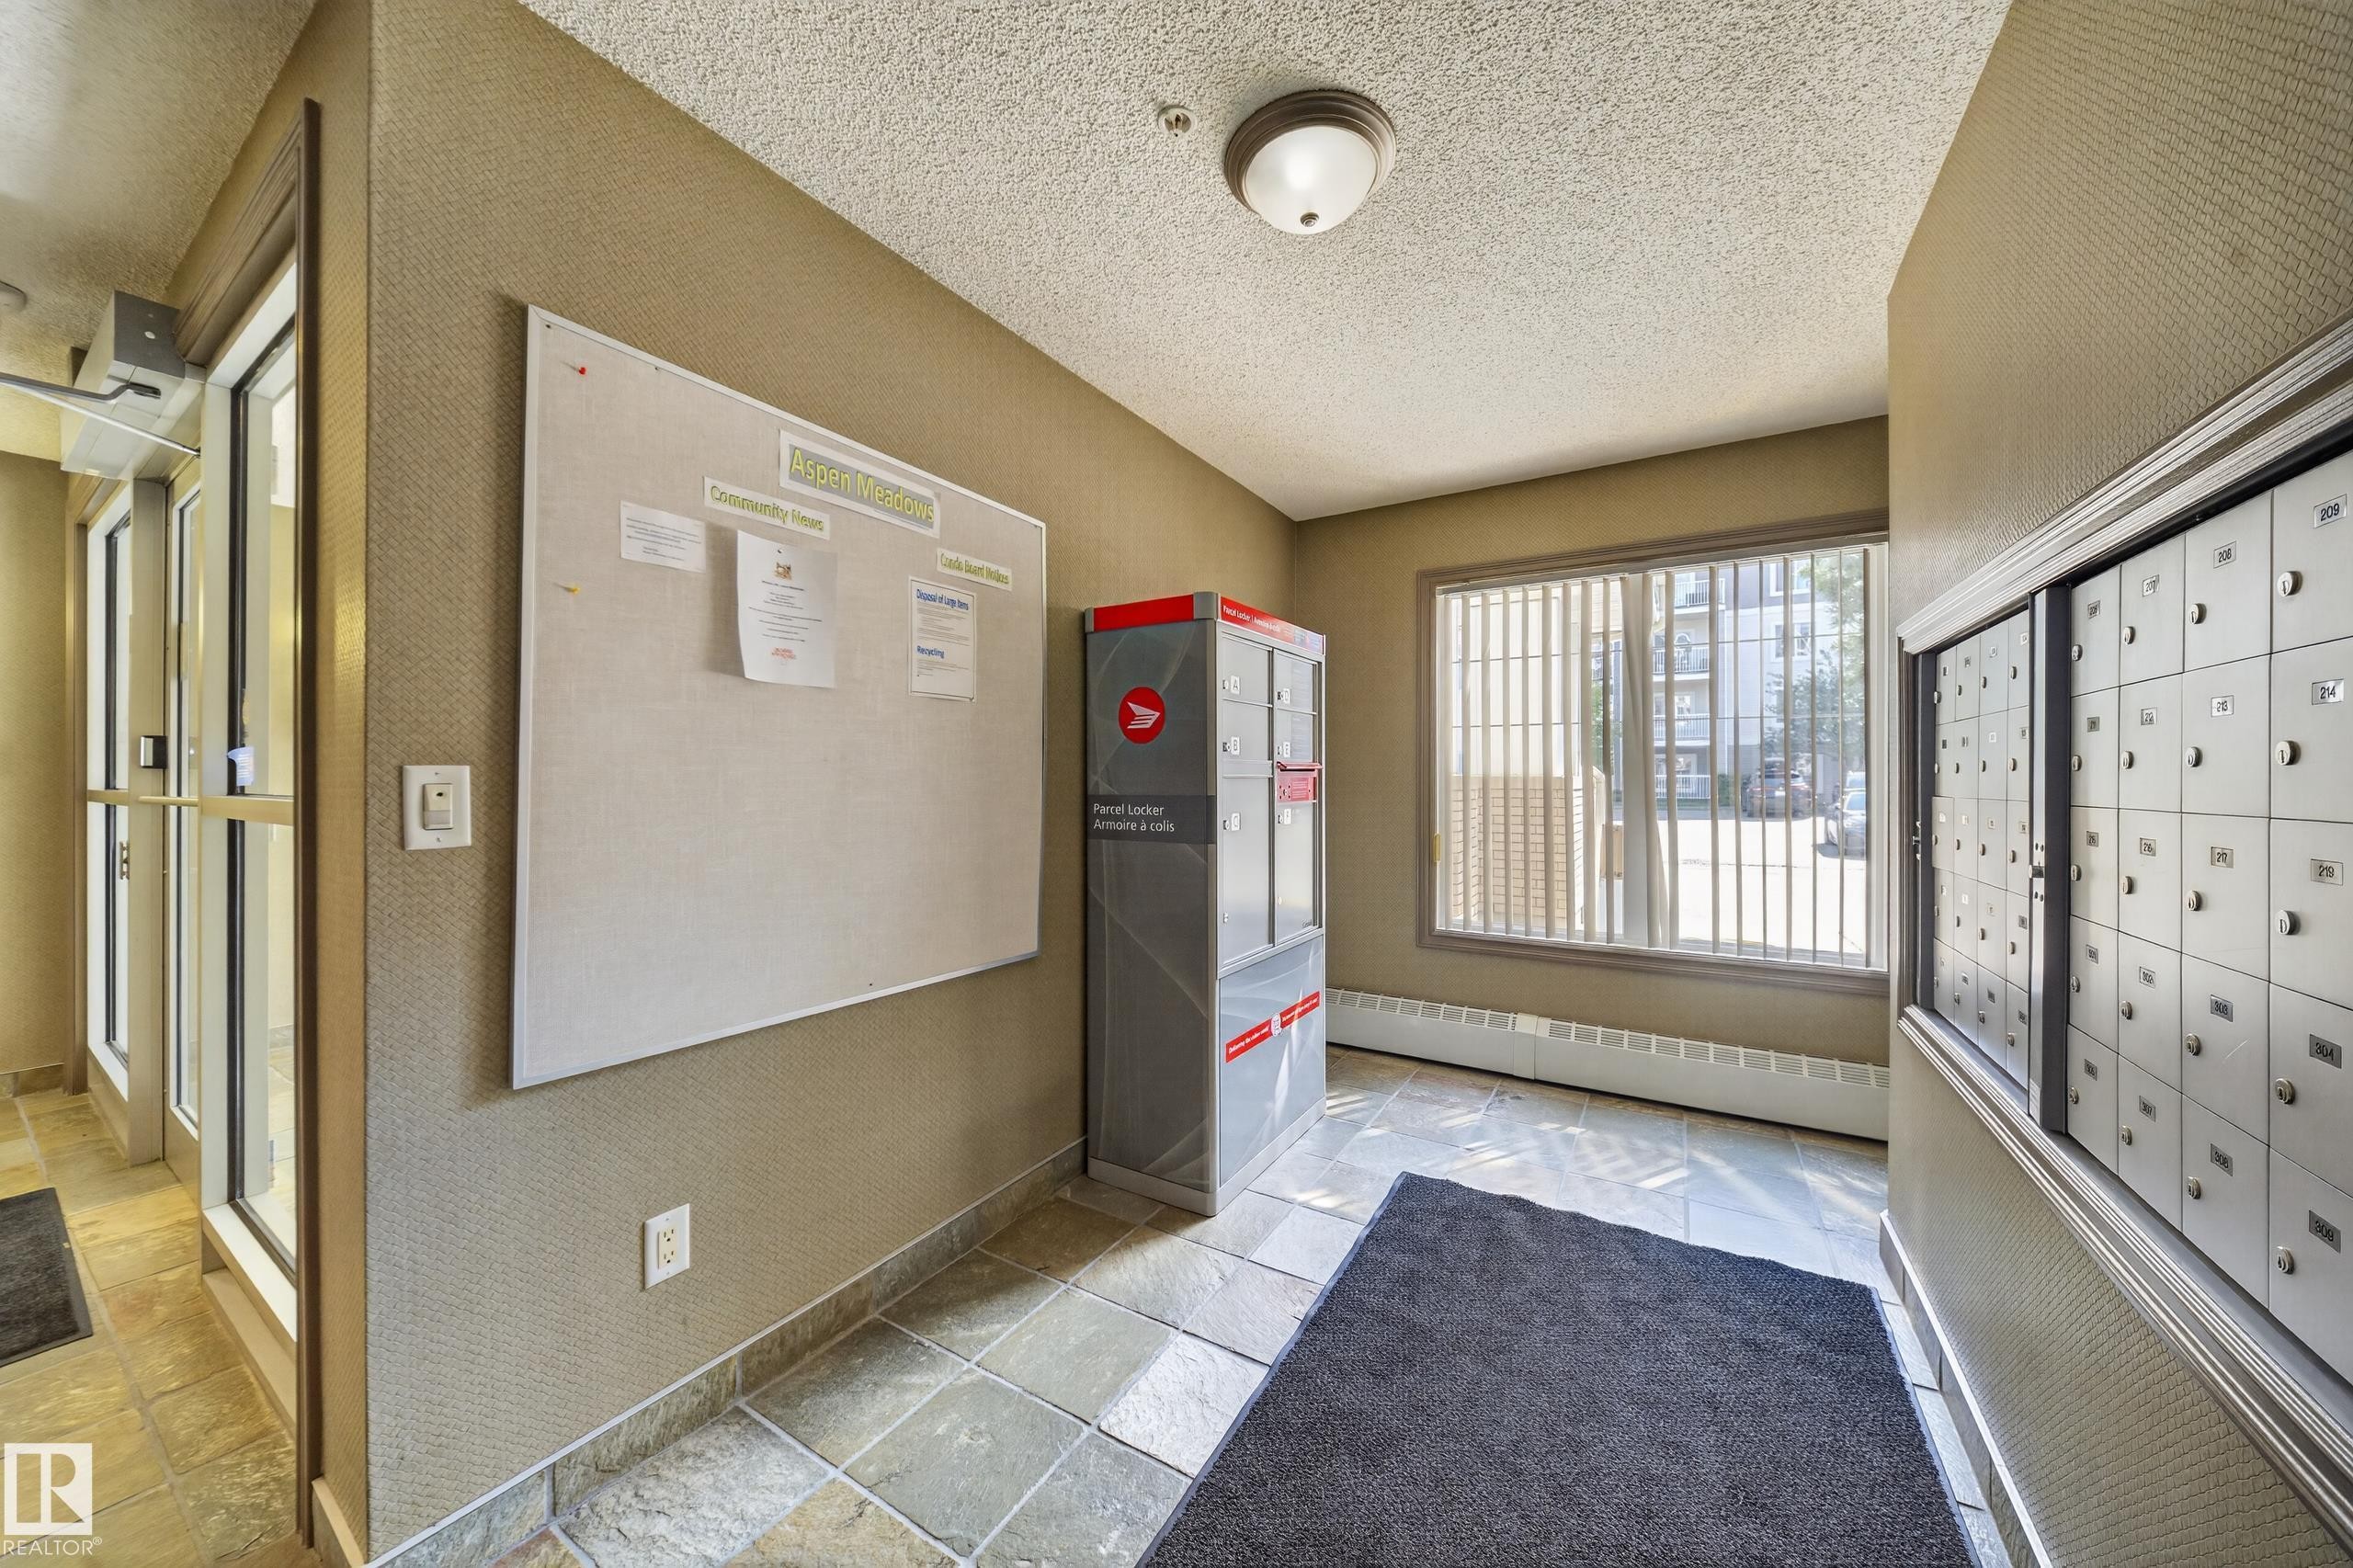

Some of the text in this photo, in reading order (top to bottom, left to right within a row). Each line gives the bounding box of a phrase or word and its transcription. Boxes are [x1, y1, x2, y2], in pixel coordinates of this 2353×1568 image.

[791, 448, 935, 522] Aspen Meadows
[710, 485, 824, 530] Community News
[2320, 503, 2340, 522] 209
[2218, 548, 2232, 562] 208
[940, 552, 1009, 585] Condo Board Notices
[2145, 580, 2156, 593] 207
[916, 588, 938, 603] Disposal
[938, 593, 944, 603] of
[945, 596, 957, 608] Large
[1222, 605, 1251, 621] Parcel Locker
[916, 645, 945, 659] Recycling
[2320, 686, 2336, 699] 214
[2216, 700, 2229, 712] 213
[1093, 803, 1165, 816] Parcel Locker
[1093, 818, 1175, 833] Armoire à colis
[2216, 852, 2228, 864] 217
[2214, 1001, 2228, 1016] 303
[2315, 1041, 2335, 1062] 304
[2315, 1220, 2335, 1242] 309
